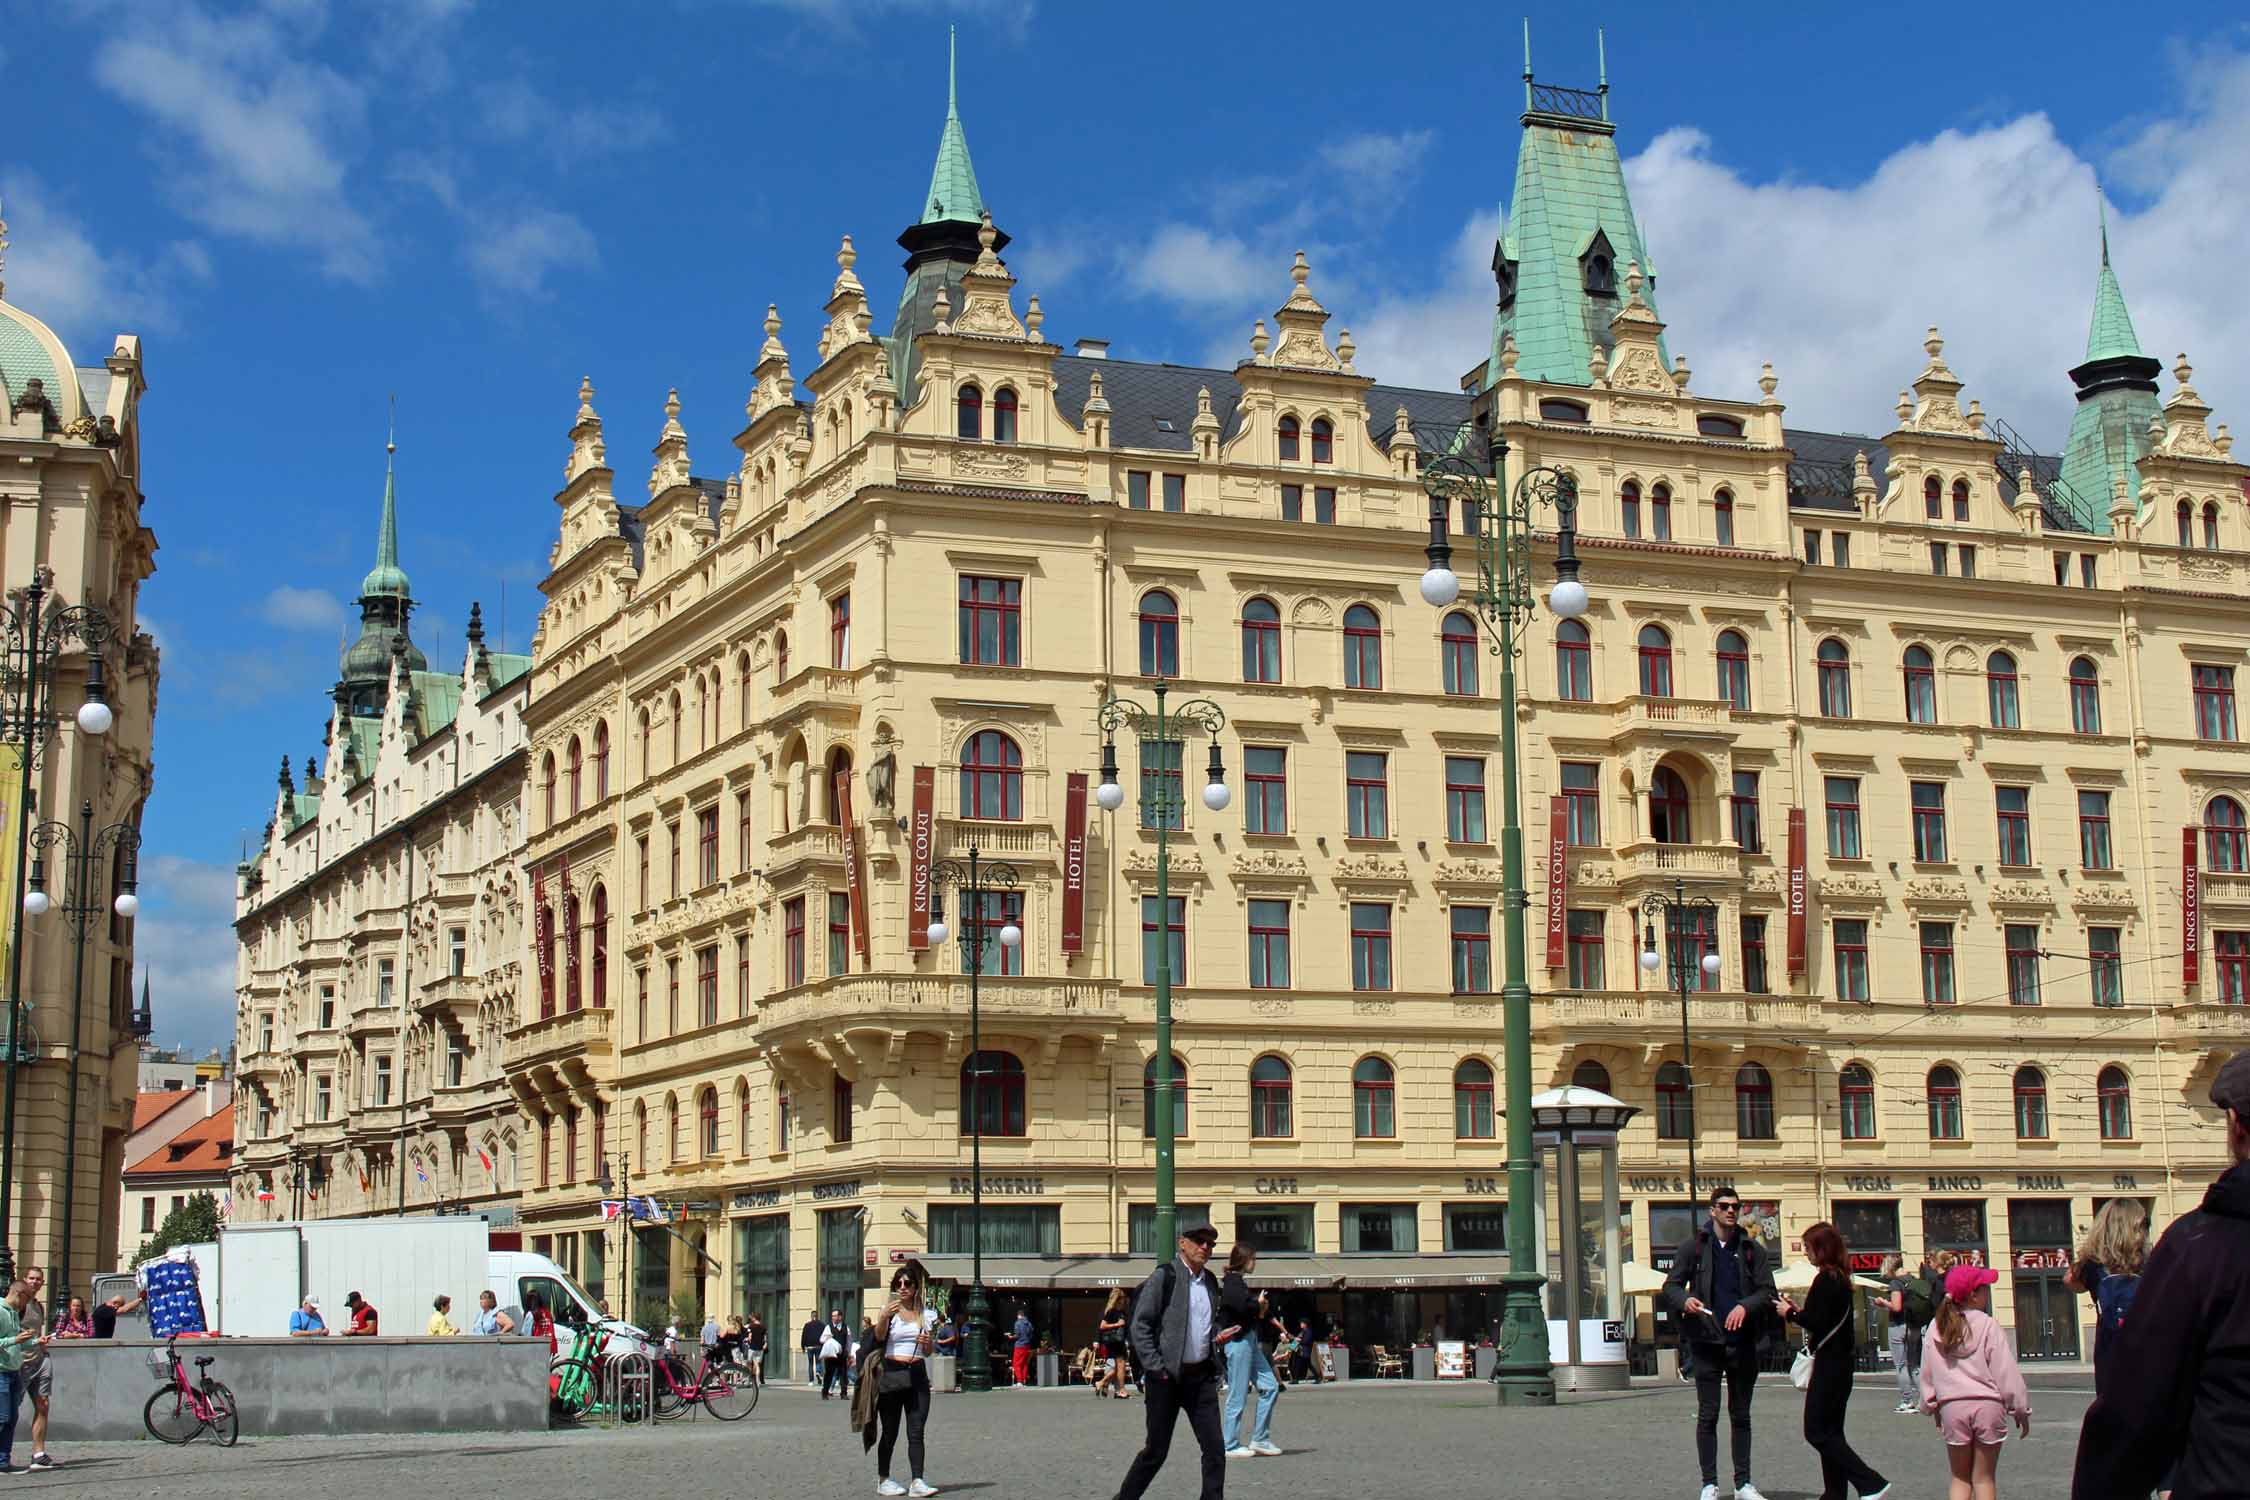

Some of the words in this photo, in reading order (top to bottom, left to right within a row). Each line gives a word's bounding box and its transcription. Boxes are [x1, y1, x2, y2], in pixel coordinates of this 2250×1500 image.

[915, 810, 928, 860] COURT
[845, 838, 855, 887] HOTEL
[1069, 836, 1082, 889] HOTEL
[1553, 838, 1563, 883] COURT
[914, 865, 927, 912] KINGS
[1792, 866, 1804, 915] HOTEL
[2186, 866, 2195, 908] COURT
[1551, 887, 1562, 932] KINGS
[2186, 911, 2195, 951] KINGS
[538, 941, 546, 977] KINGS
[1464, 1178, 1498, 1194] BAR
[1628, 1176, 1672, 1193] WOK
[1673, 1176, 1685, 1192] &
[1693, 1176, 1736, 1192] USHI
[1844, 1176, 1893, 1191] VEGAS
[1928, 1176, 1982, 1191] BANCO
[2016, 1175, 2065, 1190] PRAHA
[2113, 1175, 2137, 1190] SPA
